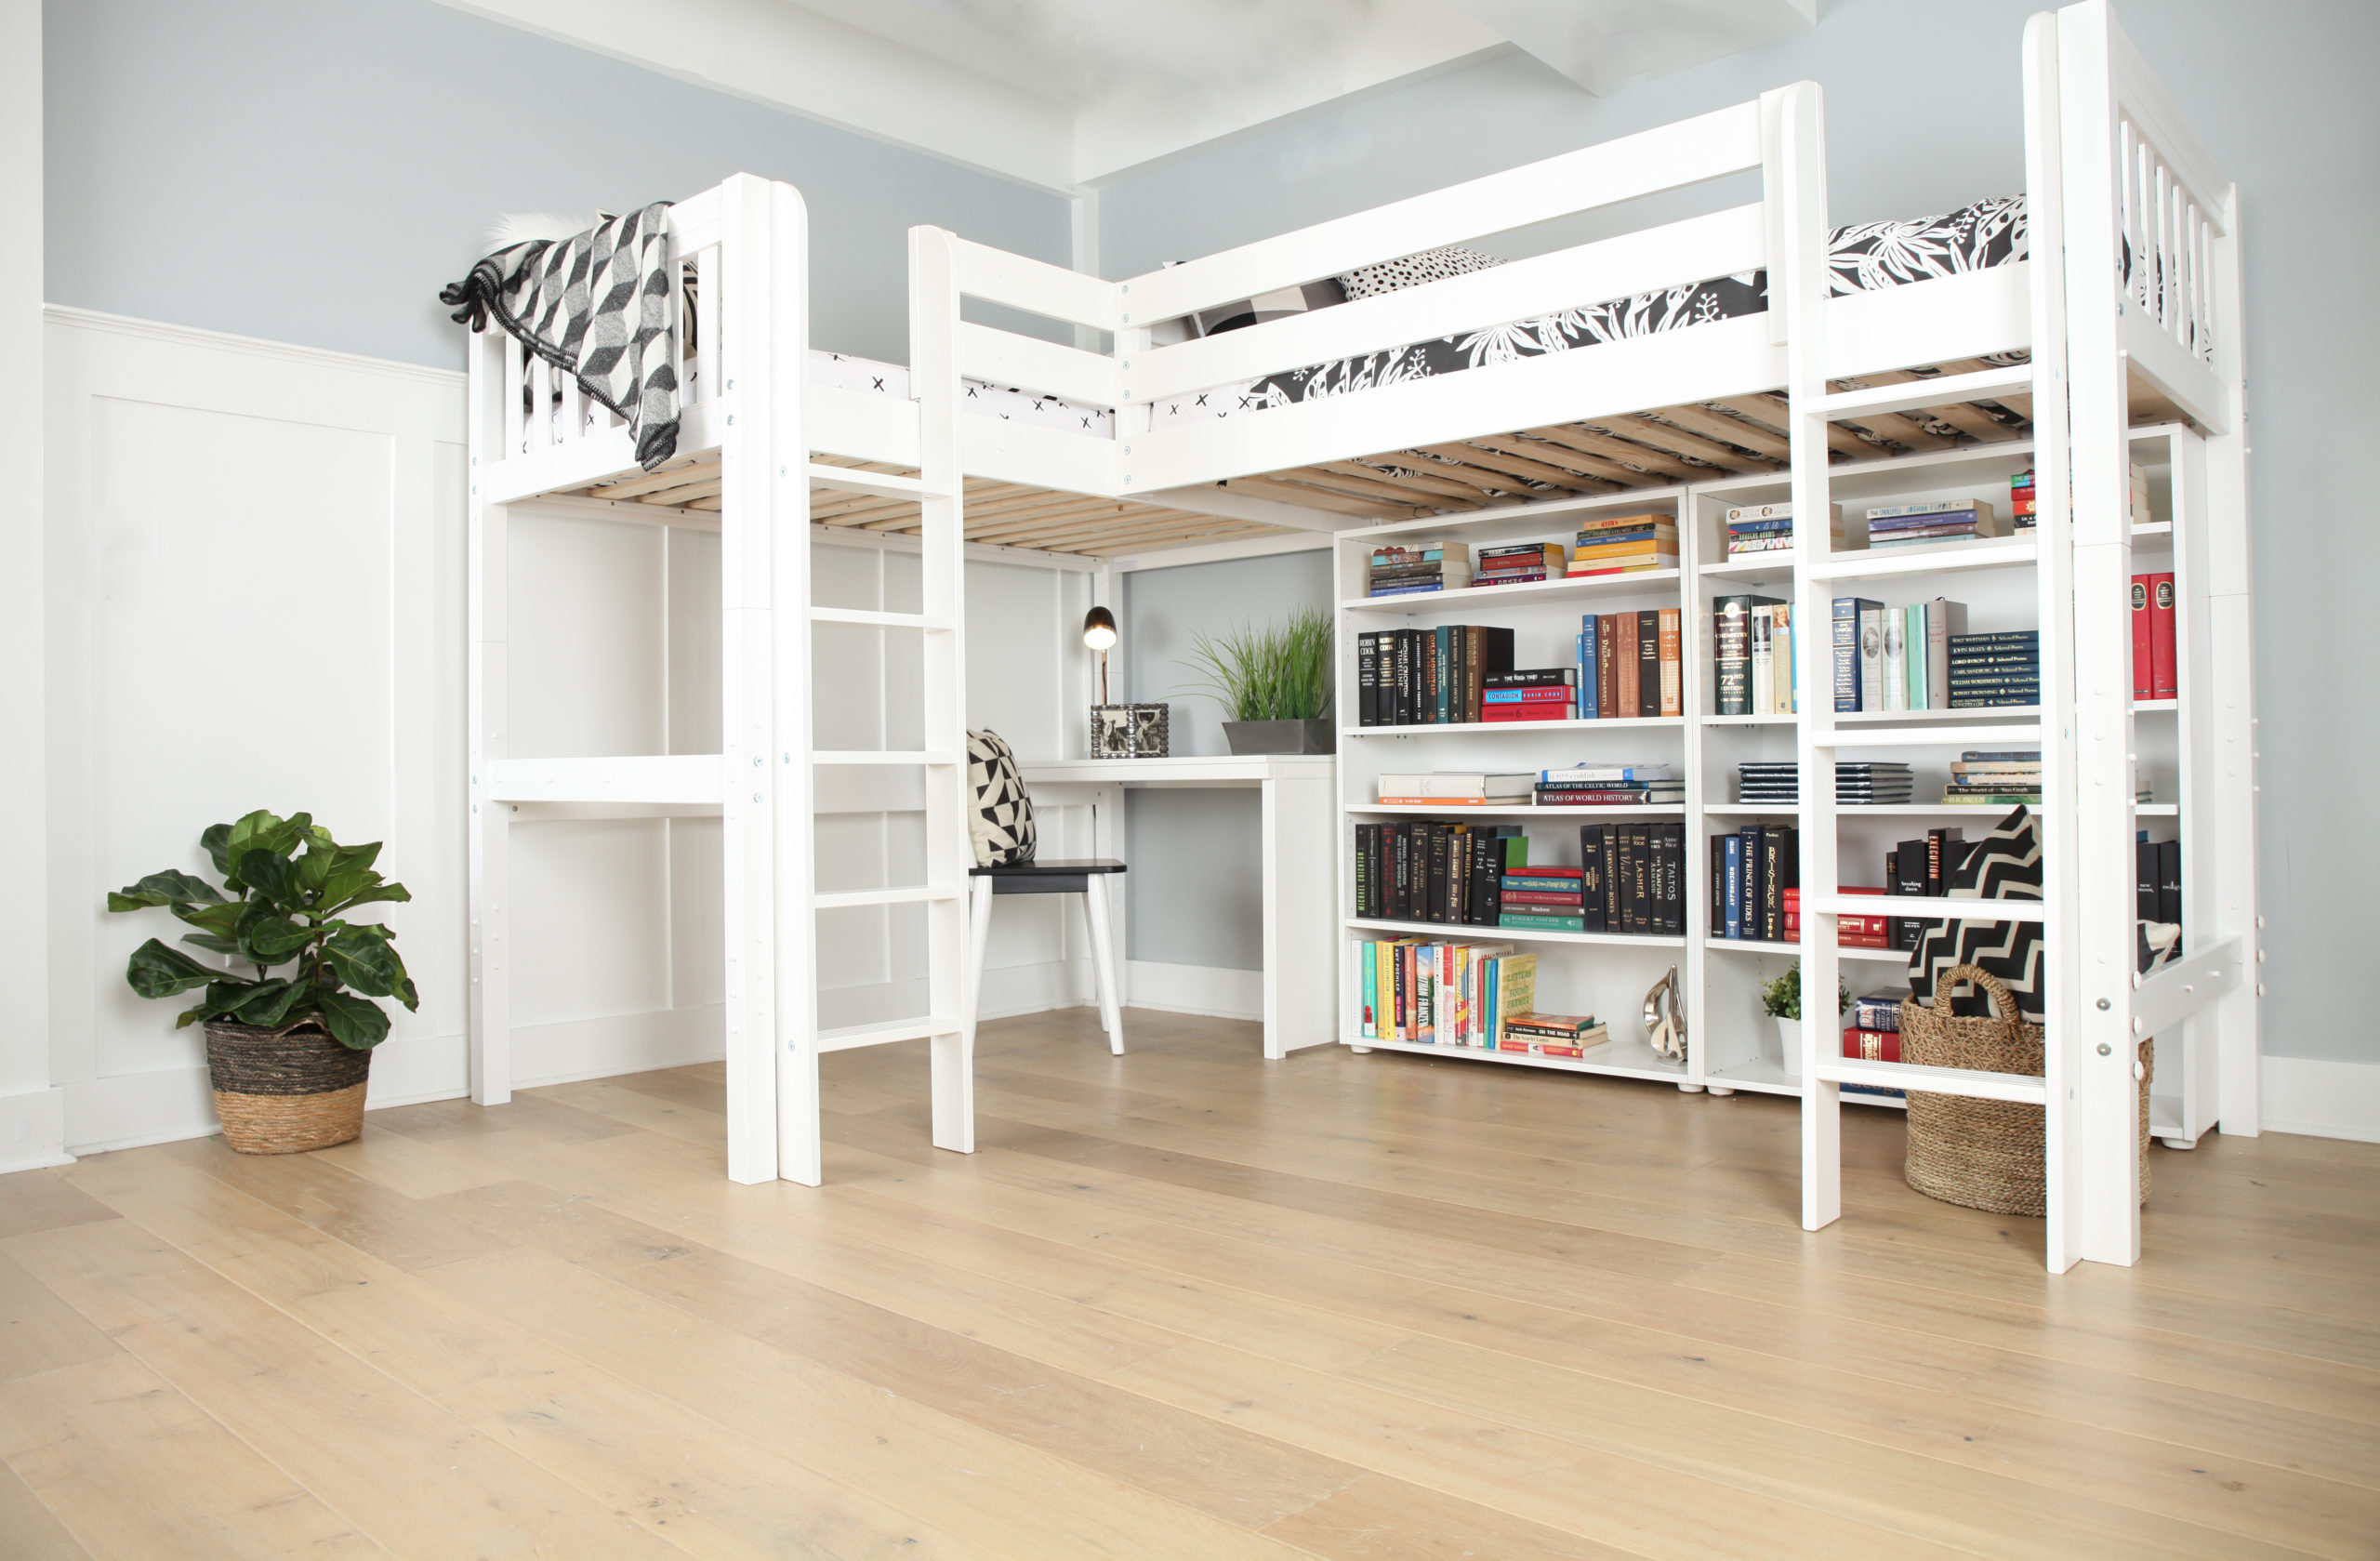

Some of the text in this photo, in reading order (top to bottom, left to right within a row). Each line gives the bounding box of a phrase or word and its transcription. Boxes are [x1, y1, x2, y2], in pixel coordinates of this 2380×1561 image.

[1359, 639, 1375, 647] ROBIN
[1515, 708, 1522, 719] 6
[1929, 835, 1939, 879] EXECUTION
[1620, 855, 1631, 882] Violin
[1635, 860, 1645, 899] LASHER
[1667, 862, 1676, 901] TALTOS
[1767, 847, 1777, 908] BRISINGR
[1746, 888, 1752, 899] OF
[1457, 966, 1461, 975] WE
[1507, 969, 1532, 982] LETTERS
[1509, 986, 1529, 997] YOUNG
[1507, 996, 1529, 1009] FARMER
[1418, 998, 1429, 1027] FRANZEN
[1861, 1009, 1872, 1025] DK
[1863, 1034, 1873, 1059] ronicle
